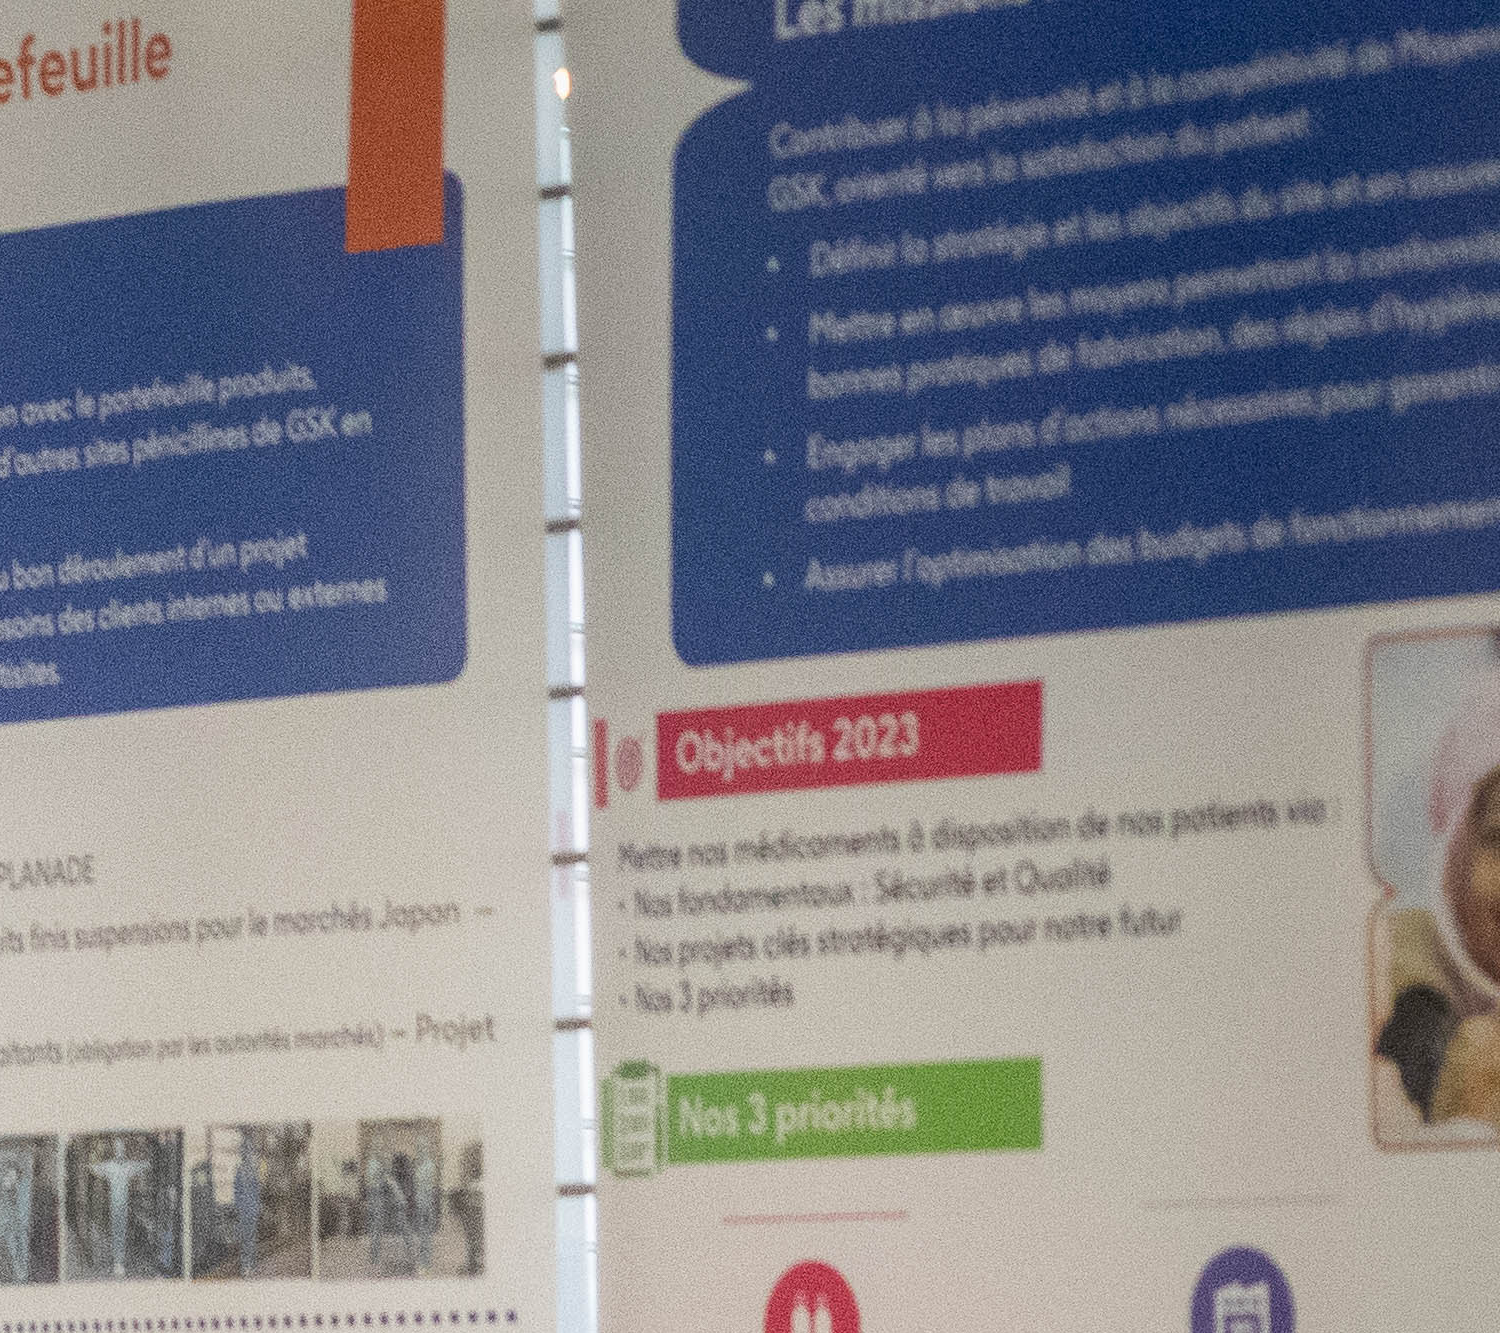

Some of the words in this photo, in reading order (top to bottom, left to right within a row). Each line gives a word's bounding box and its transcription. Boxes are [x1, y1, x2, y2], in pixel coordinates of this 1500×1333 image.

[675, 720, 826, 782] Objectifs
[832, 710, 920, 763] 2023
[678, 1096, 740, 1142] Nos
[747, 1090, 768, 1136] 3
[774, 1084, 918, 1144] priorités
